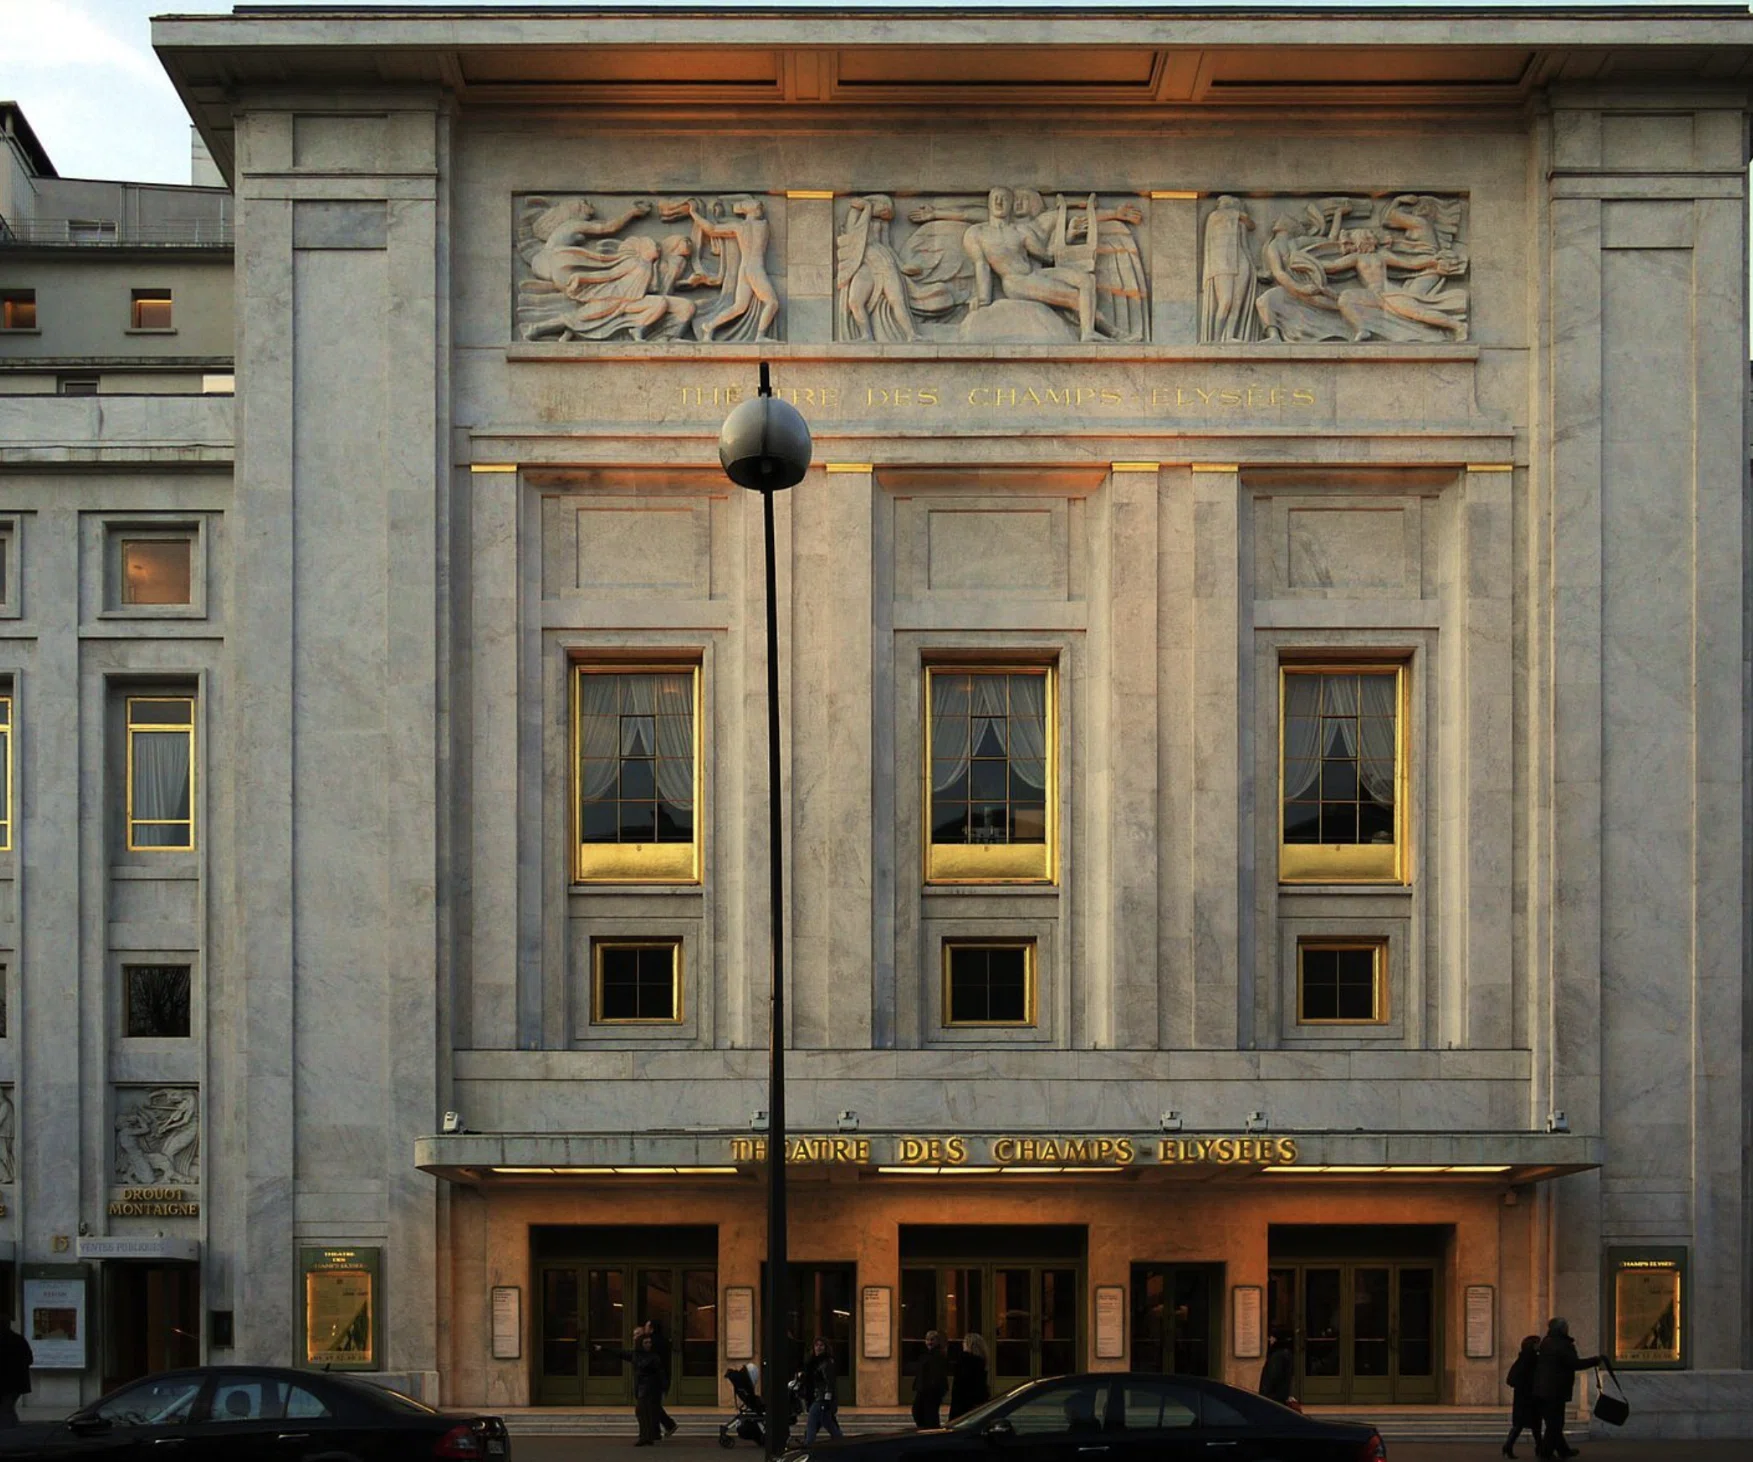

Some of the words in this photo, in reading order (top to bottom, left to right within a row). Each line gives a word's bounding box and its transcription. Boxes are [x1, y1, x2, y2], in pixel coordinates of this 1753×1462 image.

[676, 382, 839, 407] THÉTRE
[866, 387, 939, 406] DES
[731, 1138, 872, 1162] THATRE
[901, 1138, 967, 1162] DES
[121, 1187, 182, 1201] DROUOT
[109, 1203, 198, 1215] MONTAIGNE
